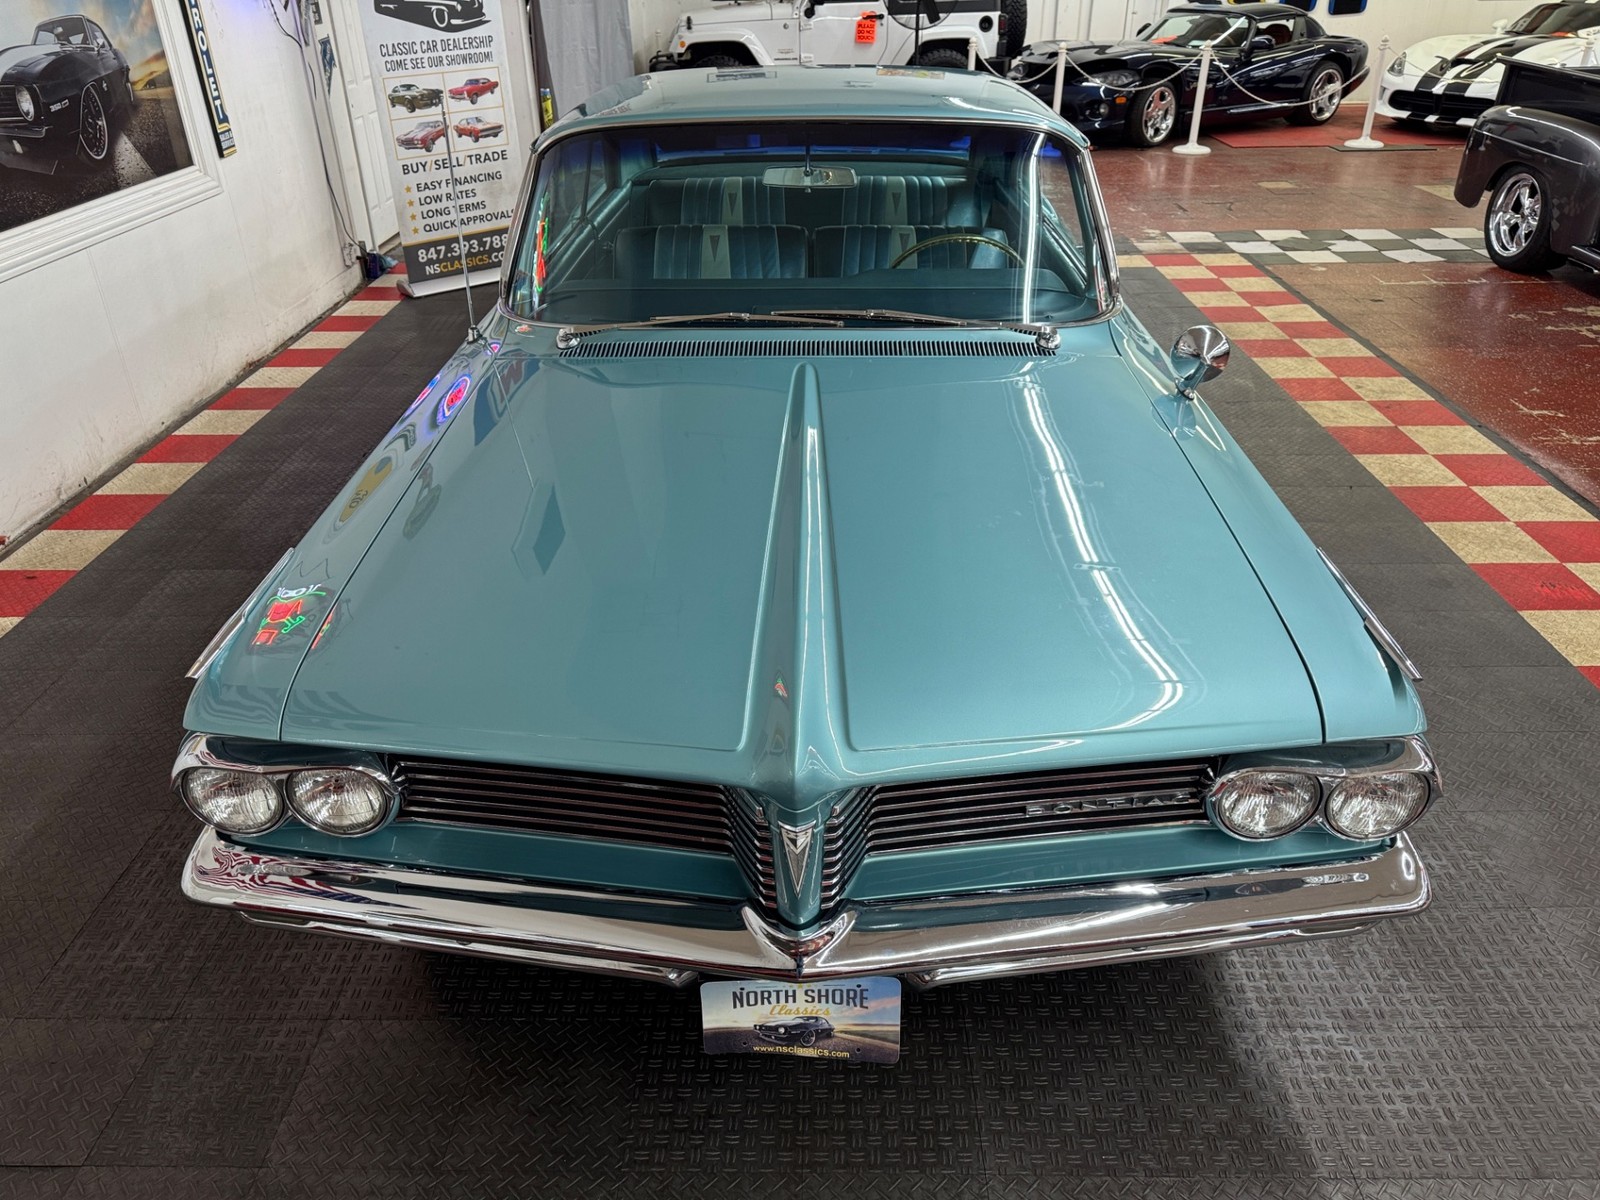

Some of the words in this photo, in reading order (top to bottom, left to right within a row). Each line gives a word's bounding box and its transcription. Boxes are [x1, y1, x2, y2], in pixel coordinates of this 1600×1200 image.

[379, 41, 418, 57] CLASSIC
[420, 39, 439, 54] CAR
[440, 35, 494, 52] DEALERSHIP
[189, 0, 223, 119] ROLET
[385, 58, 409, 72] COME
[410, 56, 426, 70] SEE
[427, 55, 445, 68] OUR
[445, 51, 494, 66] SHOWROOM!
[416, 180, 443, 193] EASY
[445, 171, 502, 188] FNANCING
[418, 193, 443, 206] LOW
[421, 207, 451, 220] LONG
[423, 219, 457, 233] QUICK
[418, 234, 508, 262] 847.393.788
[425, 251, 505, 275] NSCLASICS.CO
[732, 989, 797, 1009] NORTH
[804, 988, 869, 1009] SHORE
[769, 1004, 831, 1016] Classics
[753, 1045, 850, 1058] www.nsclassics.com
